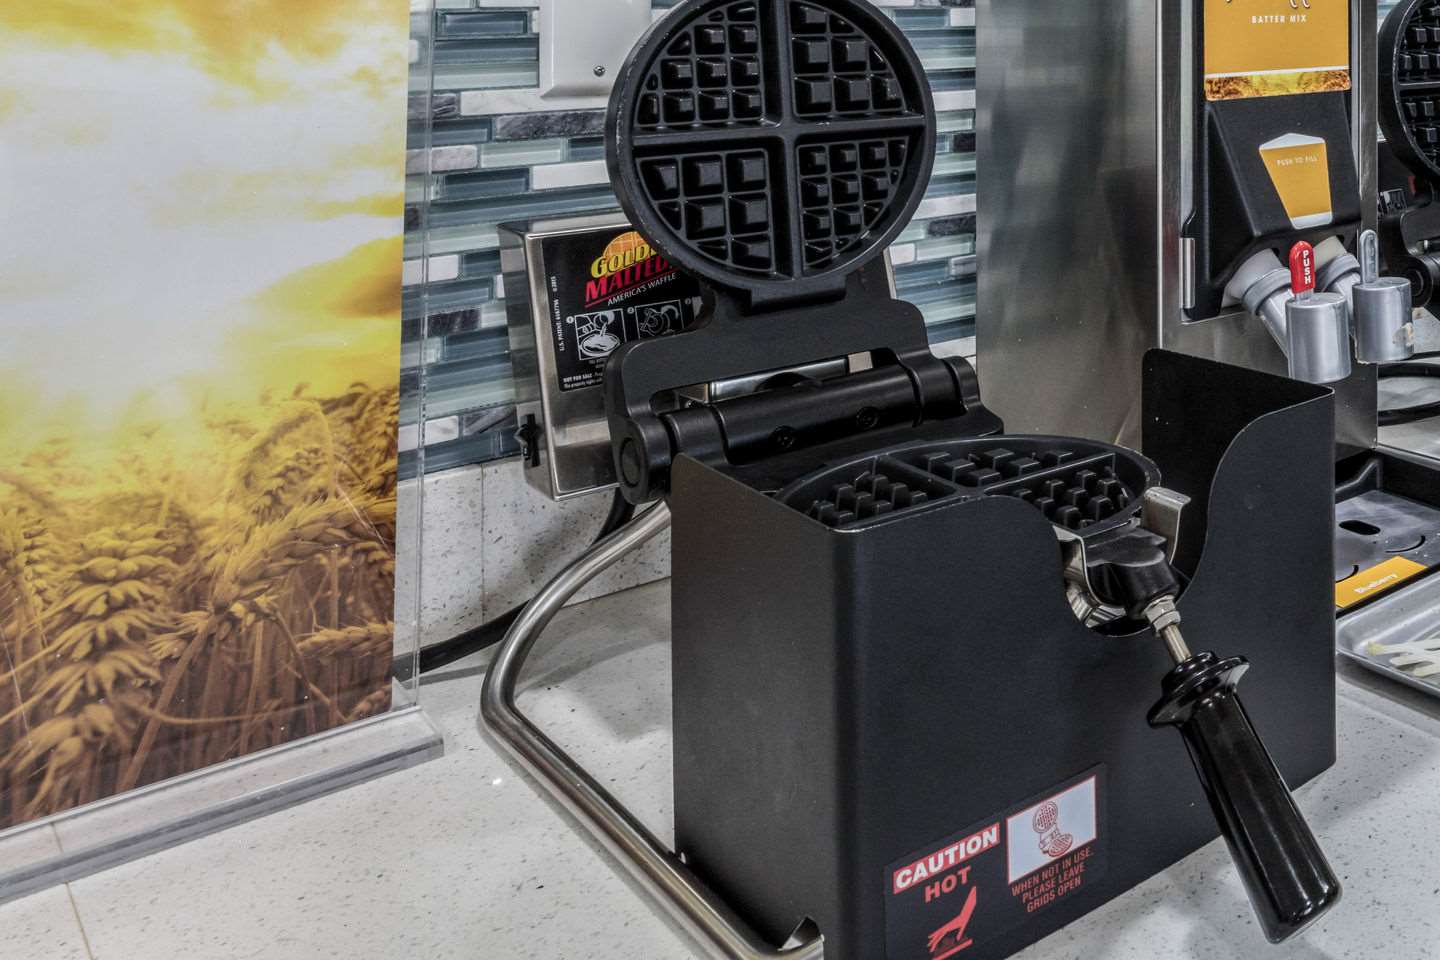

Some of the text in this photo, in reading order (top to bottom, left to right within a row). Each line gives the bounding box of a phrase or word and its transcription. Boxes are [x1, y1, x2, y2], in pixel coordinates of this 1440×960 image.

[1251, 14, 1307, 24] BATTER MIX
[591, 244, 657, 279] GOLD
[1303, 249, 1311, 285] PUSH
[608, 272, 676, 307] AMERICA'S WAFFLE
[895, 826, 998, 889] CAUTION
[1011, 874, 1040, 896] WHEN
[1042, 864, 1060, 881] NOT
[1062, 857, 1072, 869] IN
[924, 865, 972, 904] HOT
[1023, 863, 1085, 904] PLEASE LEAVE
[1027, 875, 1081, 913] GRIDS OPEN
